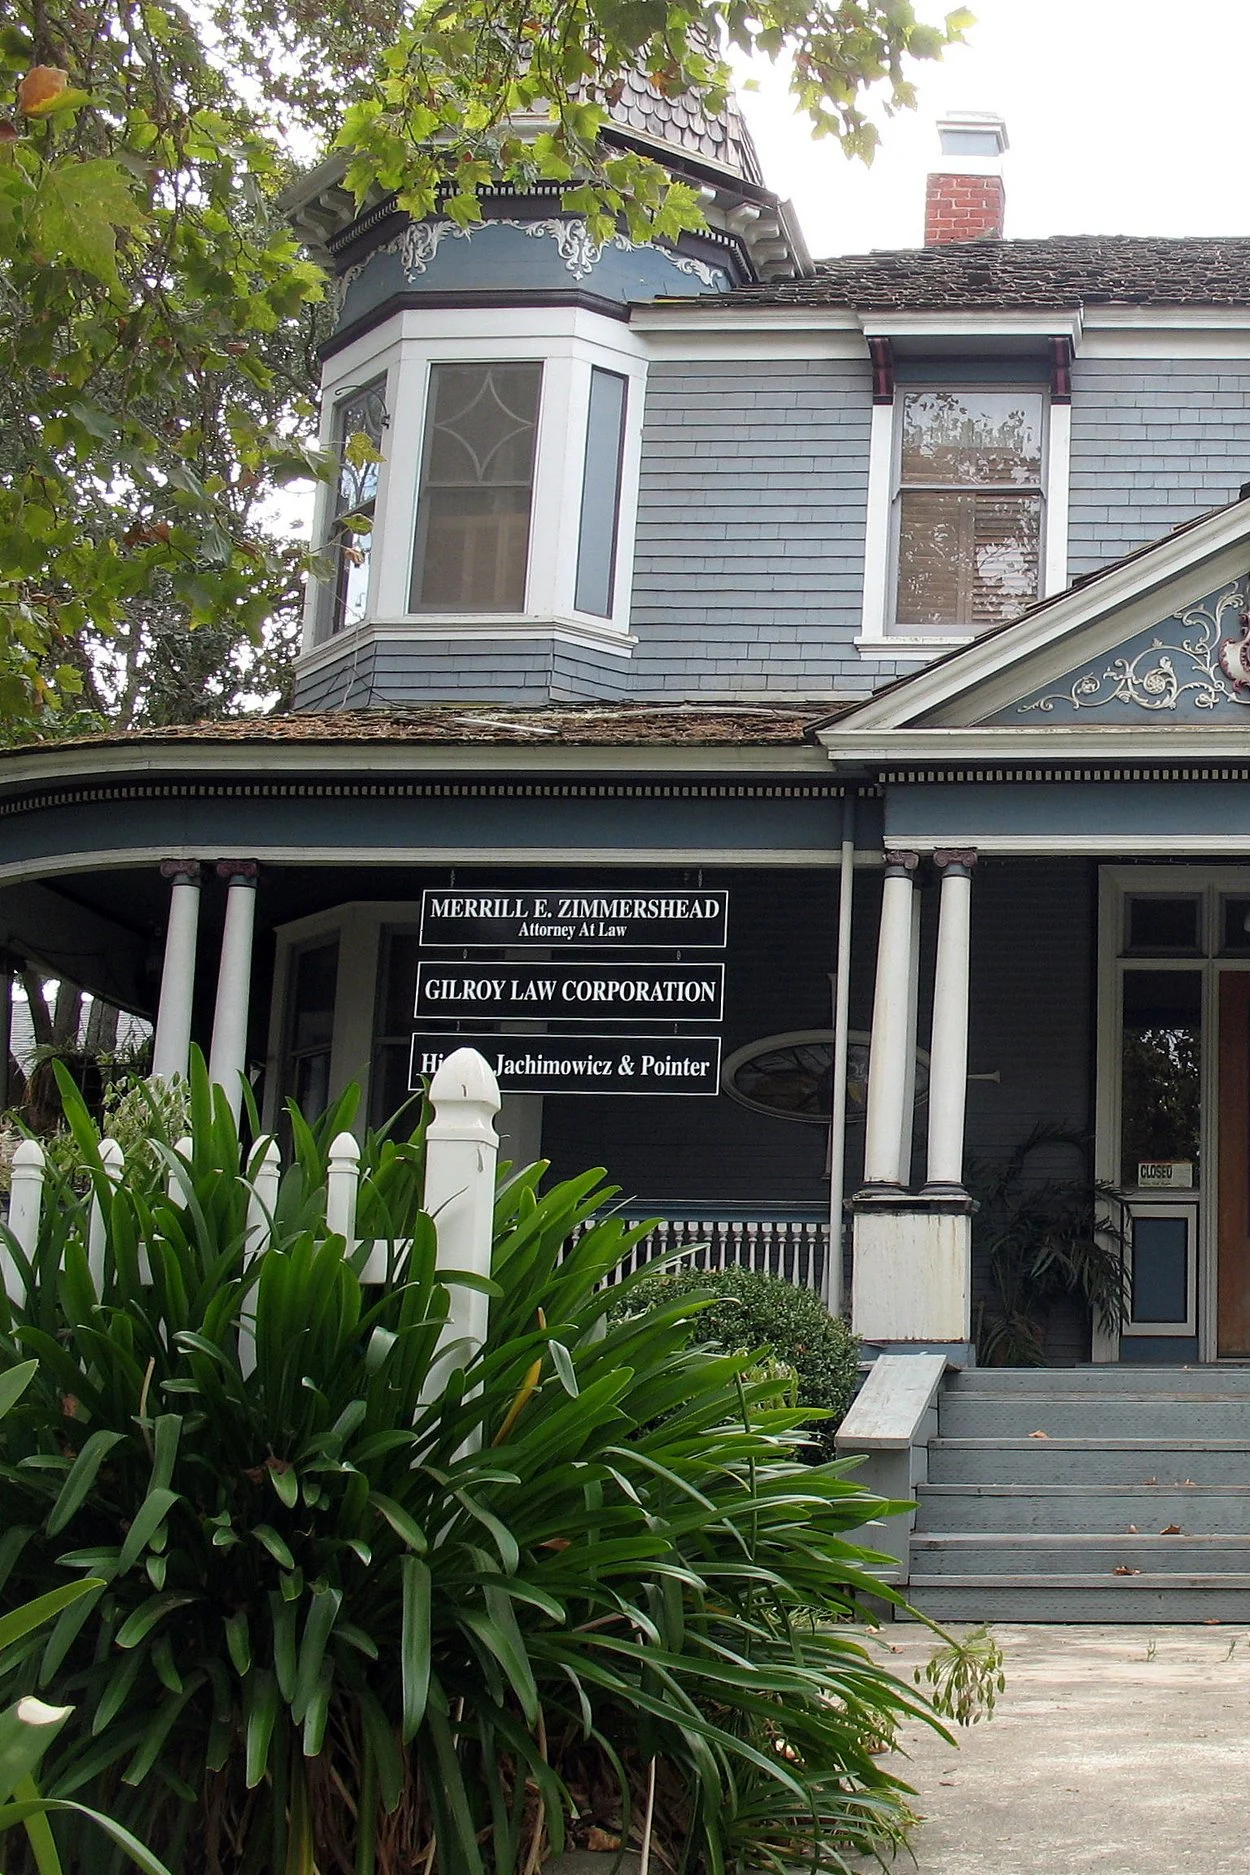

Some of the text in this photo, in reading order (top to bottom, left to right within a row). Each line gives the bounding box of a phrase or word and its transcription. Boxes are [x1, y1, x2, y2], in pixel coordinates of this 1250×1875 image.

[430, 898, 720, 919] MERRILL E. ZIMMERSHEAD
[518, 921, 628, 940] Attorney At Law
[424, 979, 717, 1003] GILROY LAW CORPORATION
[494, 1053, 710, 1077] Jachimowicz & Pointer
[1140, 1164, 1173, 1179] CLOSED
